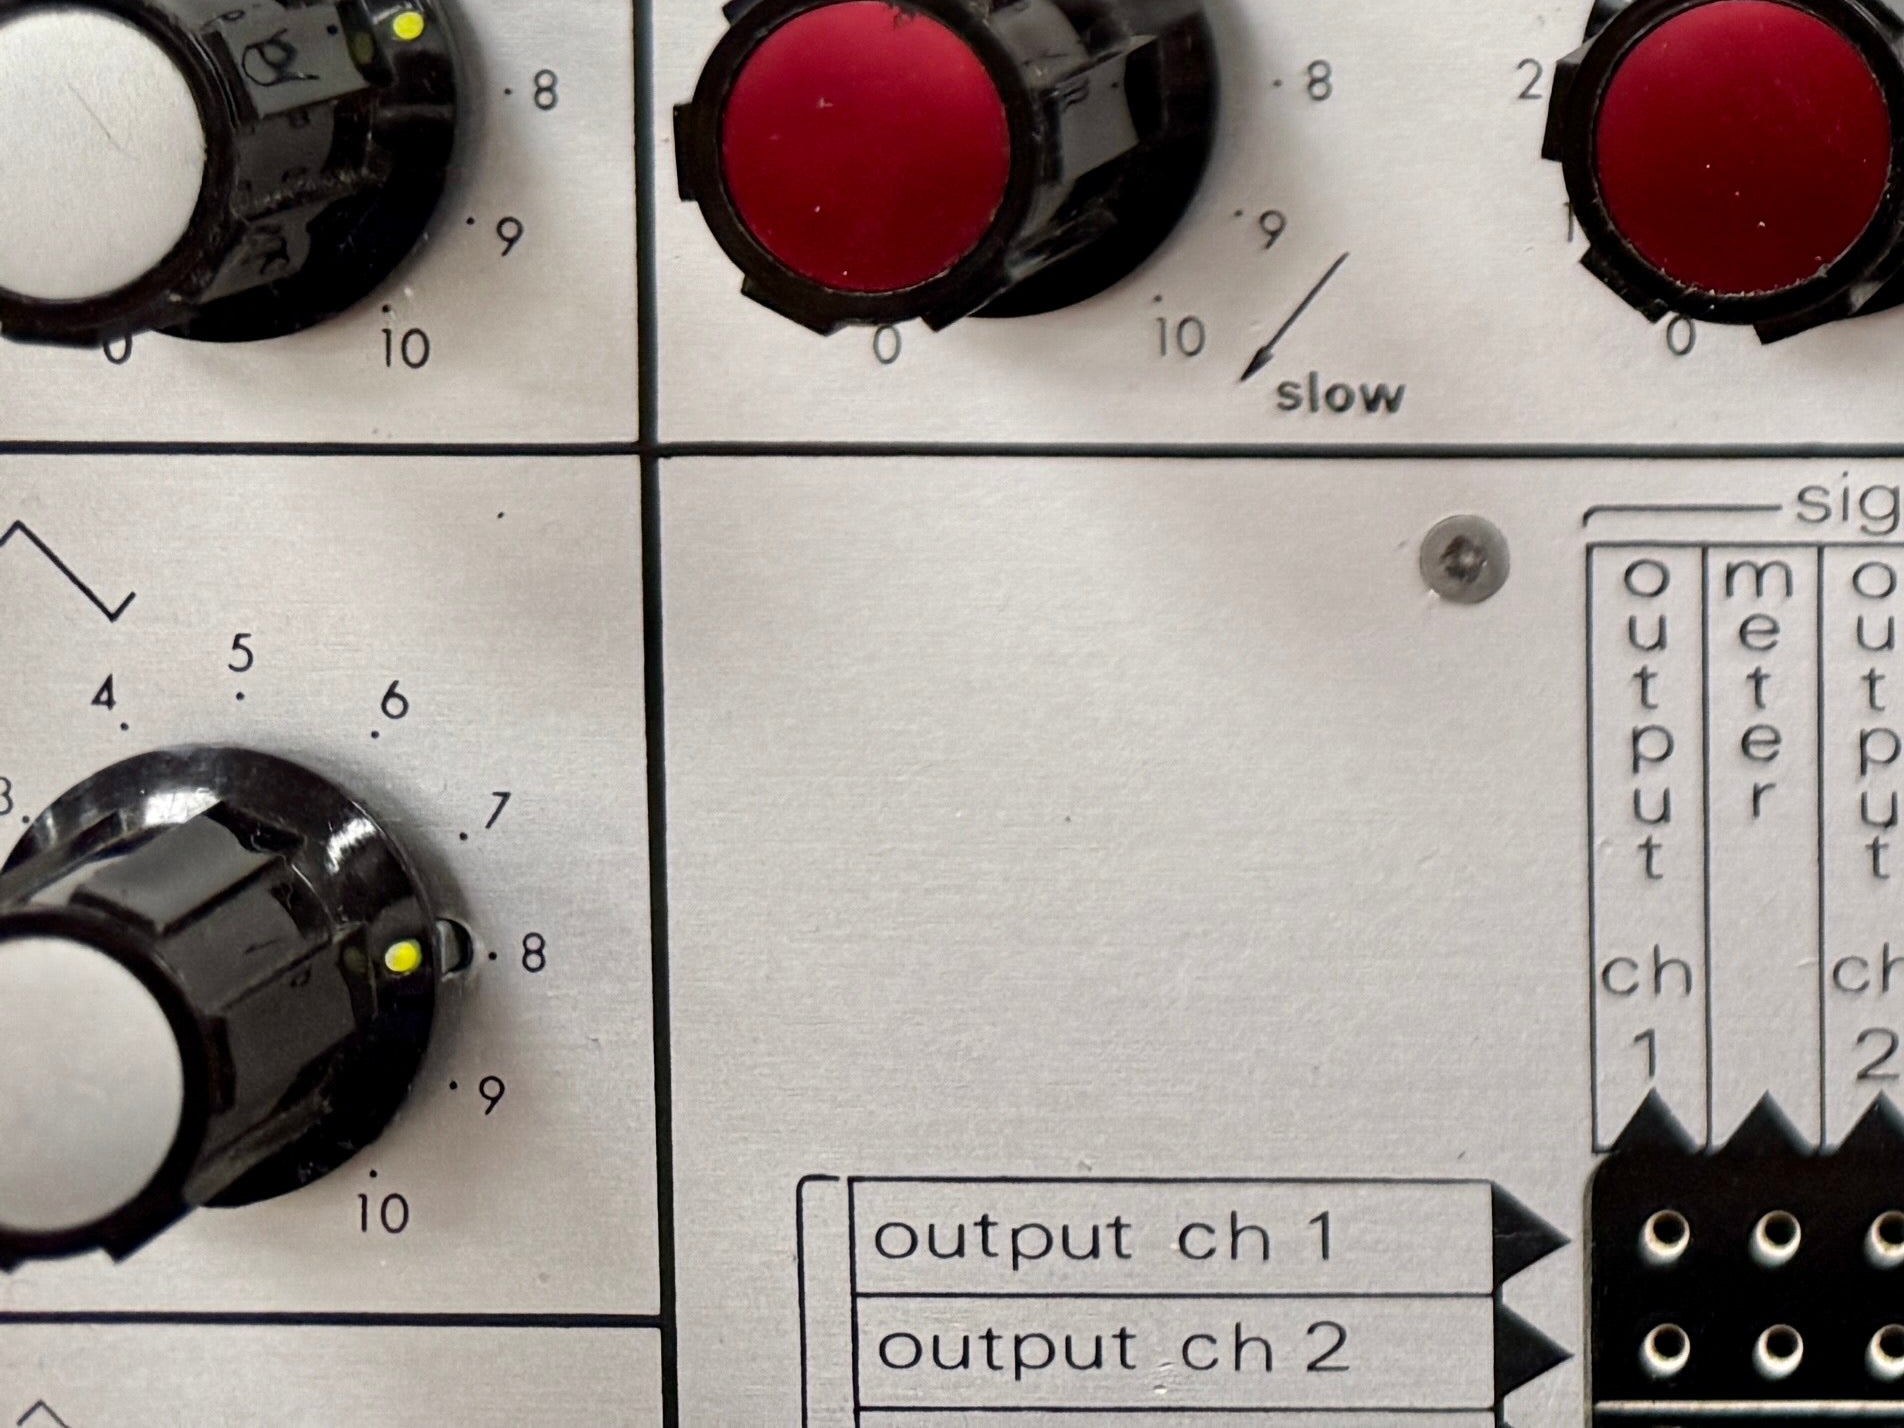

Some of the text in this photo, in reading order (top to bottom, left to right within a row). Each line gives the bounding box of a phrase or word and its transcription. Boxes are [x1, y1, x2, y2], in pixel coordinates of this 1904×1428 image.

[1304, 60, 1332, 102] 8
[381, 327, 430, 370] 10
[1275, 370, 1406, 416] slow
[90, 673, 117, 711] 4
[380, 680, 410, 720] 6
[522, 932, 547, 973] 8
[1600, 944, 1692, 999] ch
[1632, 1028, 1656, 1081] 1
[1853, 1027, 1900, 1088] 2
[874, 1210, 1330, 1274] output ch 1
[878, 1320, 1350, 1384] output ch 2
